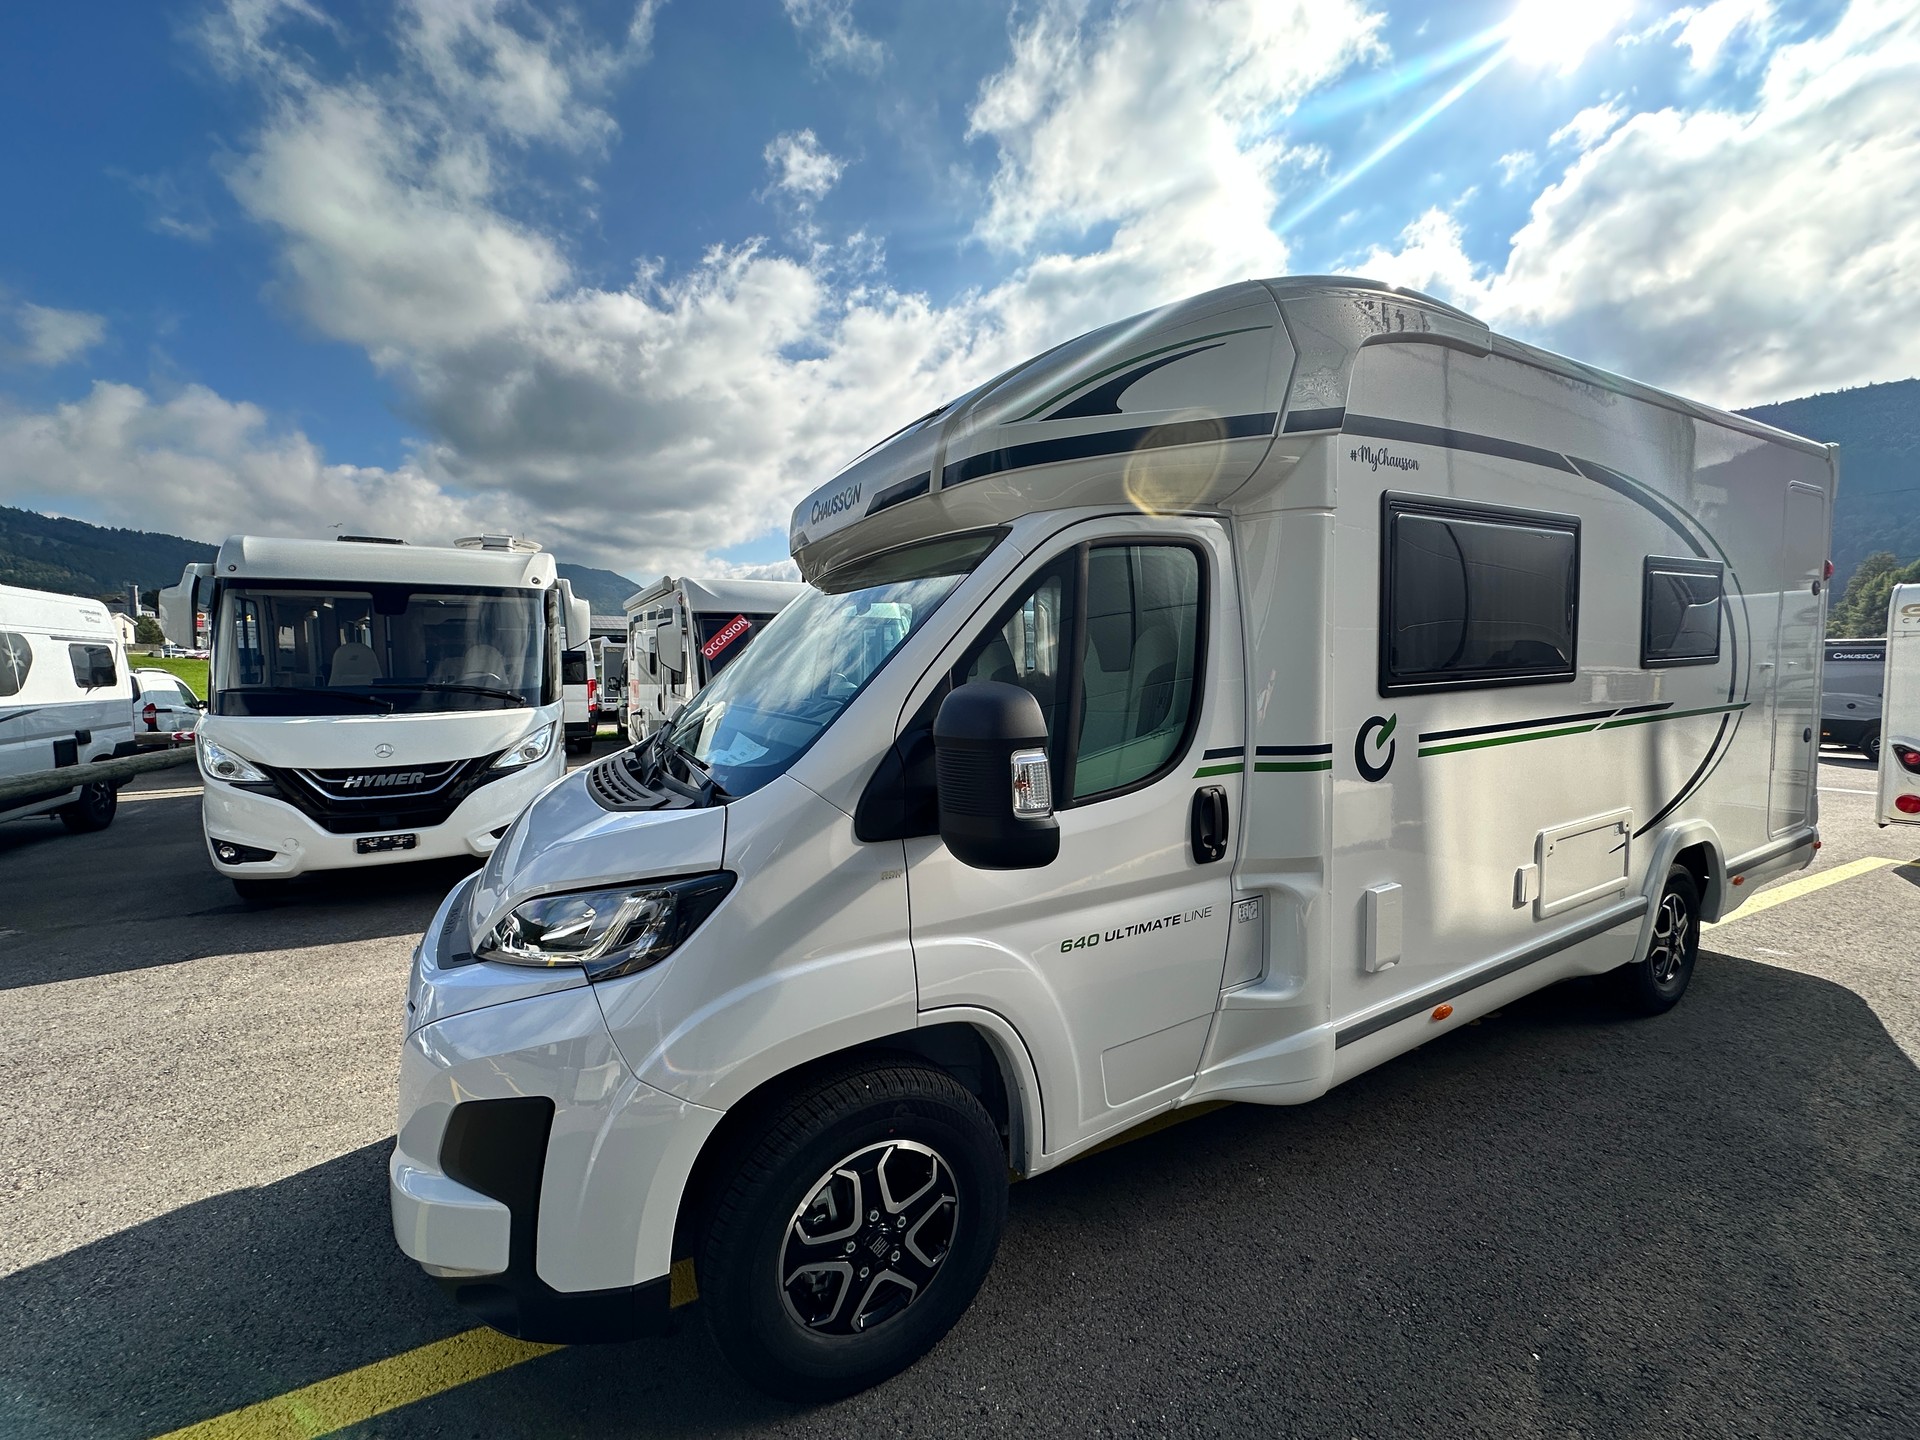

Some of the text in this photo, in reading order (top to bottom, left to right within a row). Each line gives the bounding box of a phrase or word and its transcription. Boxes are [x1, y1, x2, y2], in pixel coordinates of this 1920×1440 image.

[1350, 445, 1419, 472] #MyChausson
[811, 482, 862, 525] CHAUSSON
[704, 617, 748, 656] OCCASION
[343, 772, 425, 788] HYMER
[1060, 906, 1213, 953] 640 ULTIMATE LINE
